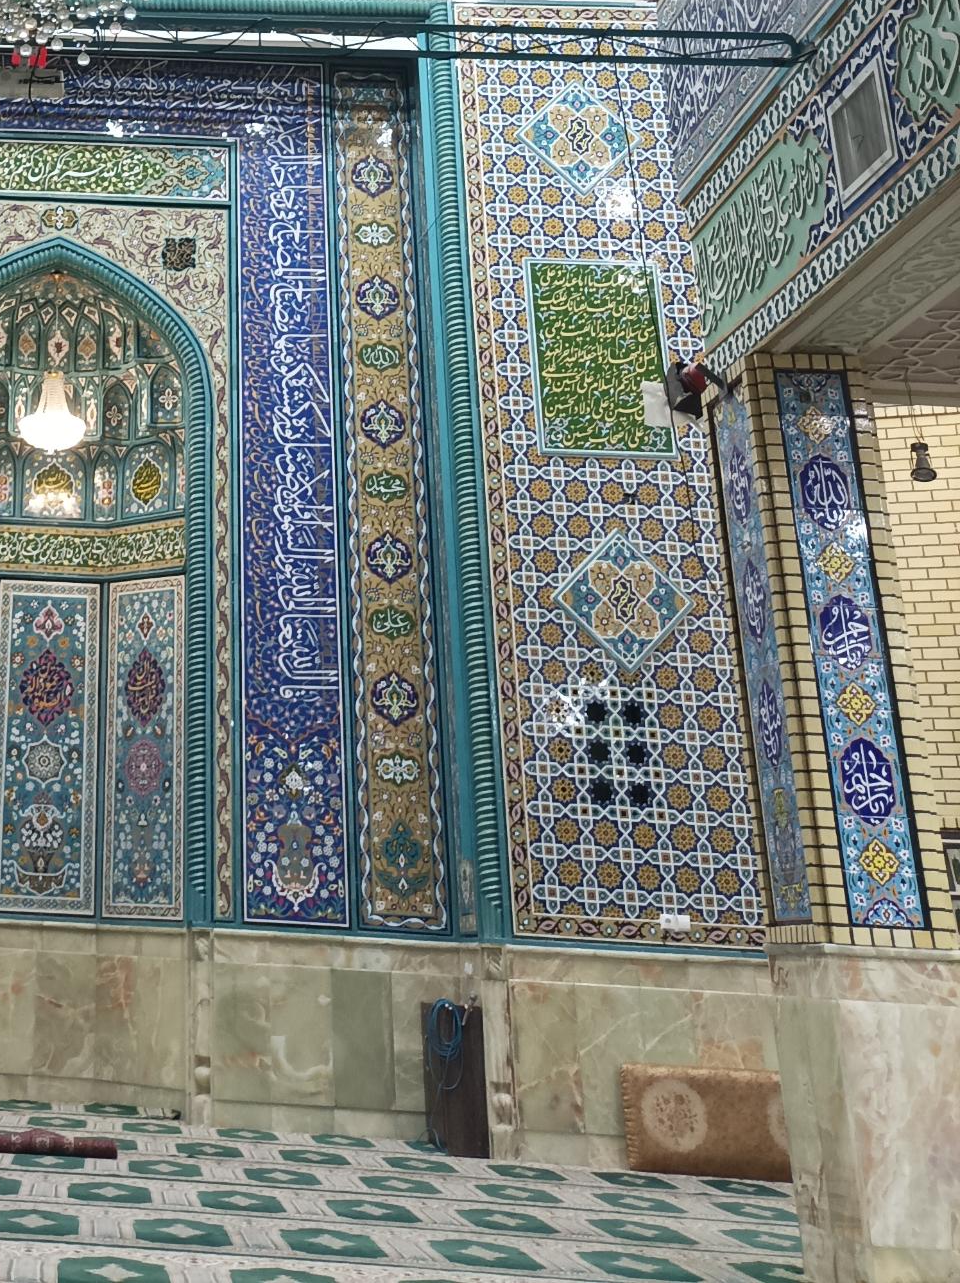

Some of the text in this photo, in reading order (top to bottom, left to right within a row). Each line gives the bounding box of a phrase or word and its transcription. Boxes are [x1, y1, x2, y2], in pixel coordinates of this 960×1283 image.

[363, 342, 400, 370] الله
[365, 471, 407, 502] محمد
[371, 608, 412, 636] علی
